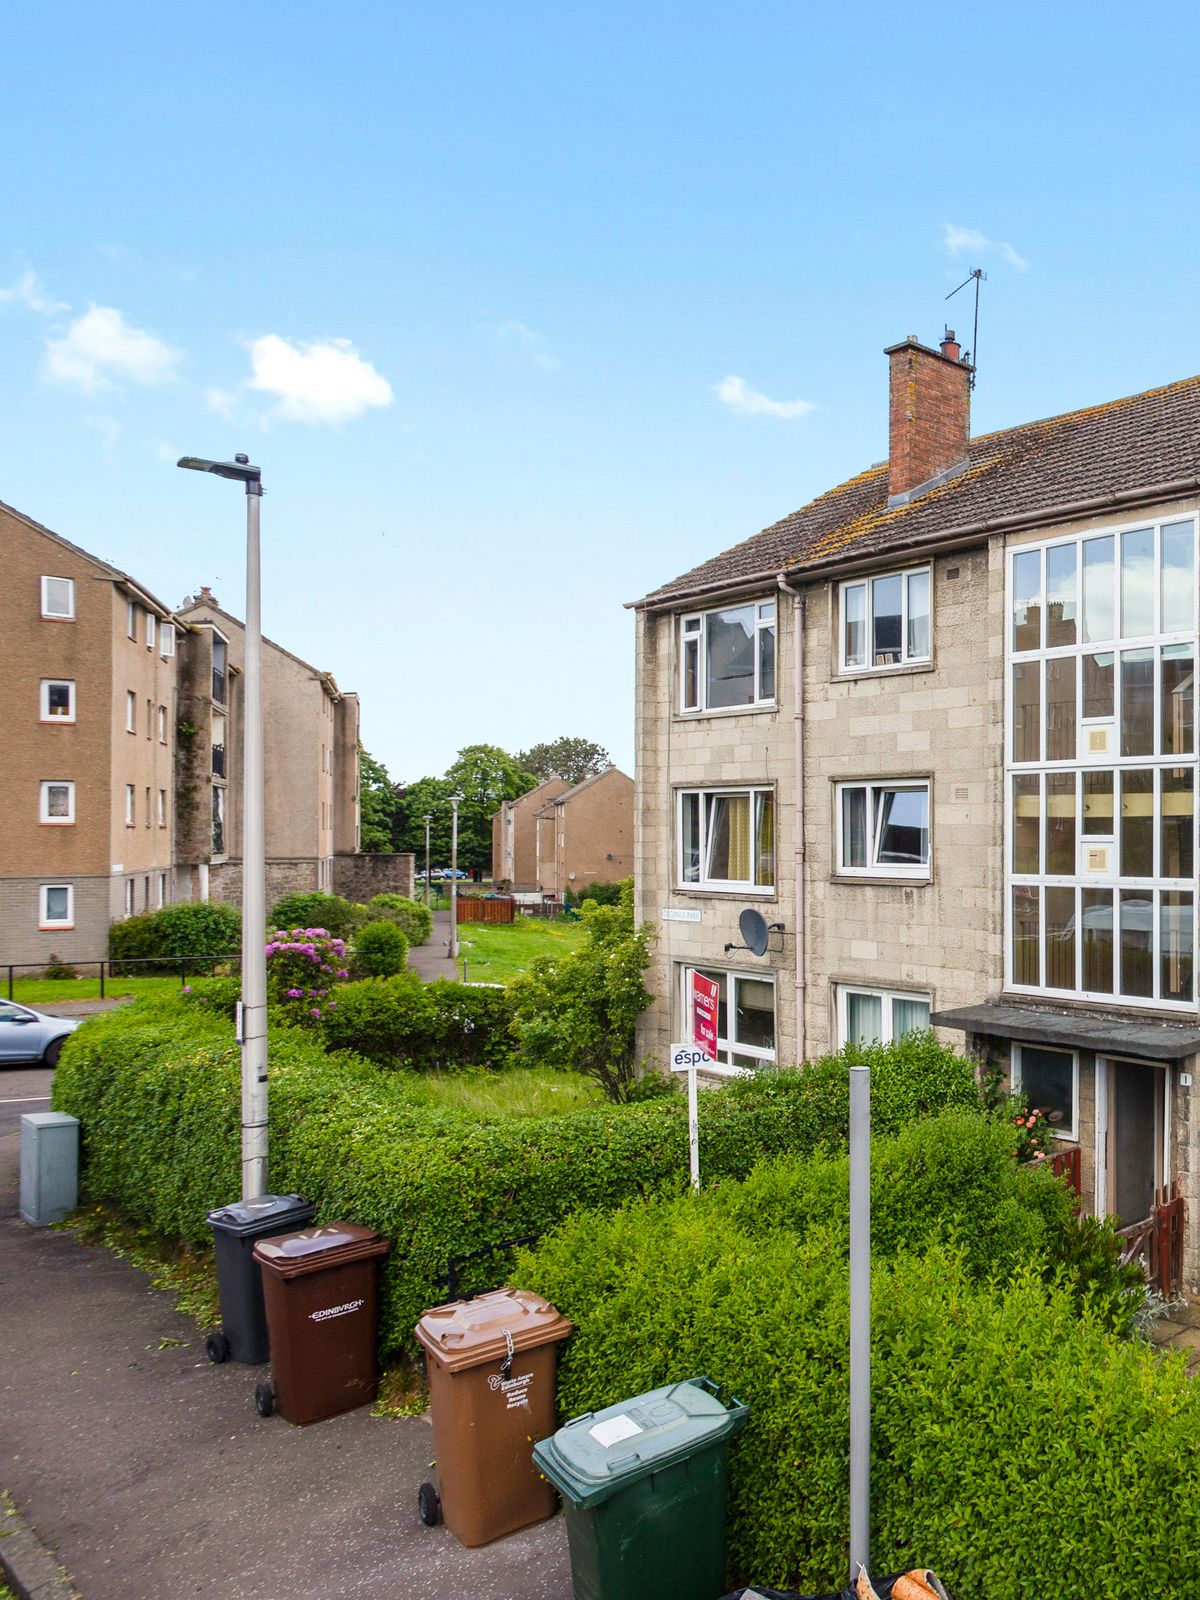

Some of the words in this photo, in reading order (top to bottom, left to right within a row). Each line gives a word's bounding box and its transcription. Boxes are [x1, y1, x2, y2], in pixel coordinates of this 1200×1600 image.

[674, 1050, 711, 1067] espc
[507, 1387, 528, 1398] Reduce
[507, 1398, 529, 1409] Recycle
[508, 1394, 526, 1403] Reuse
